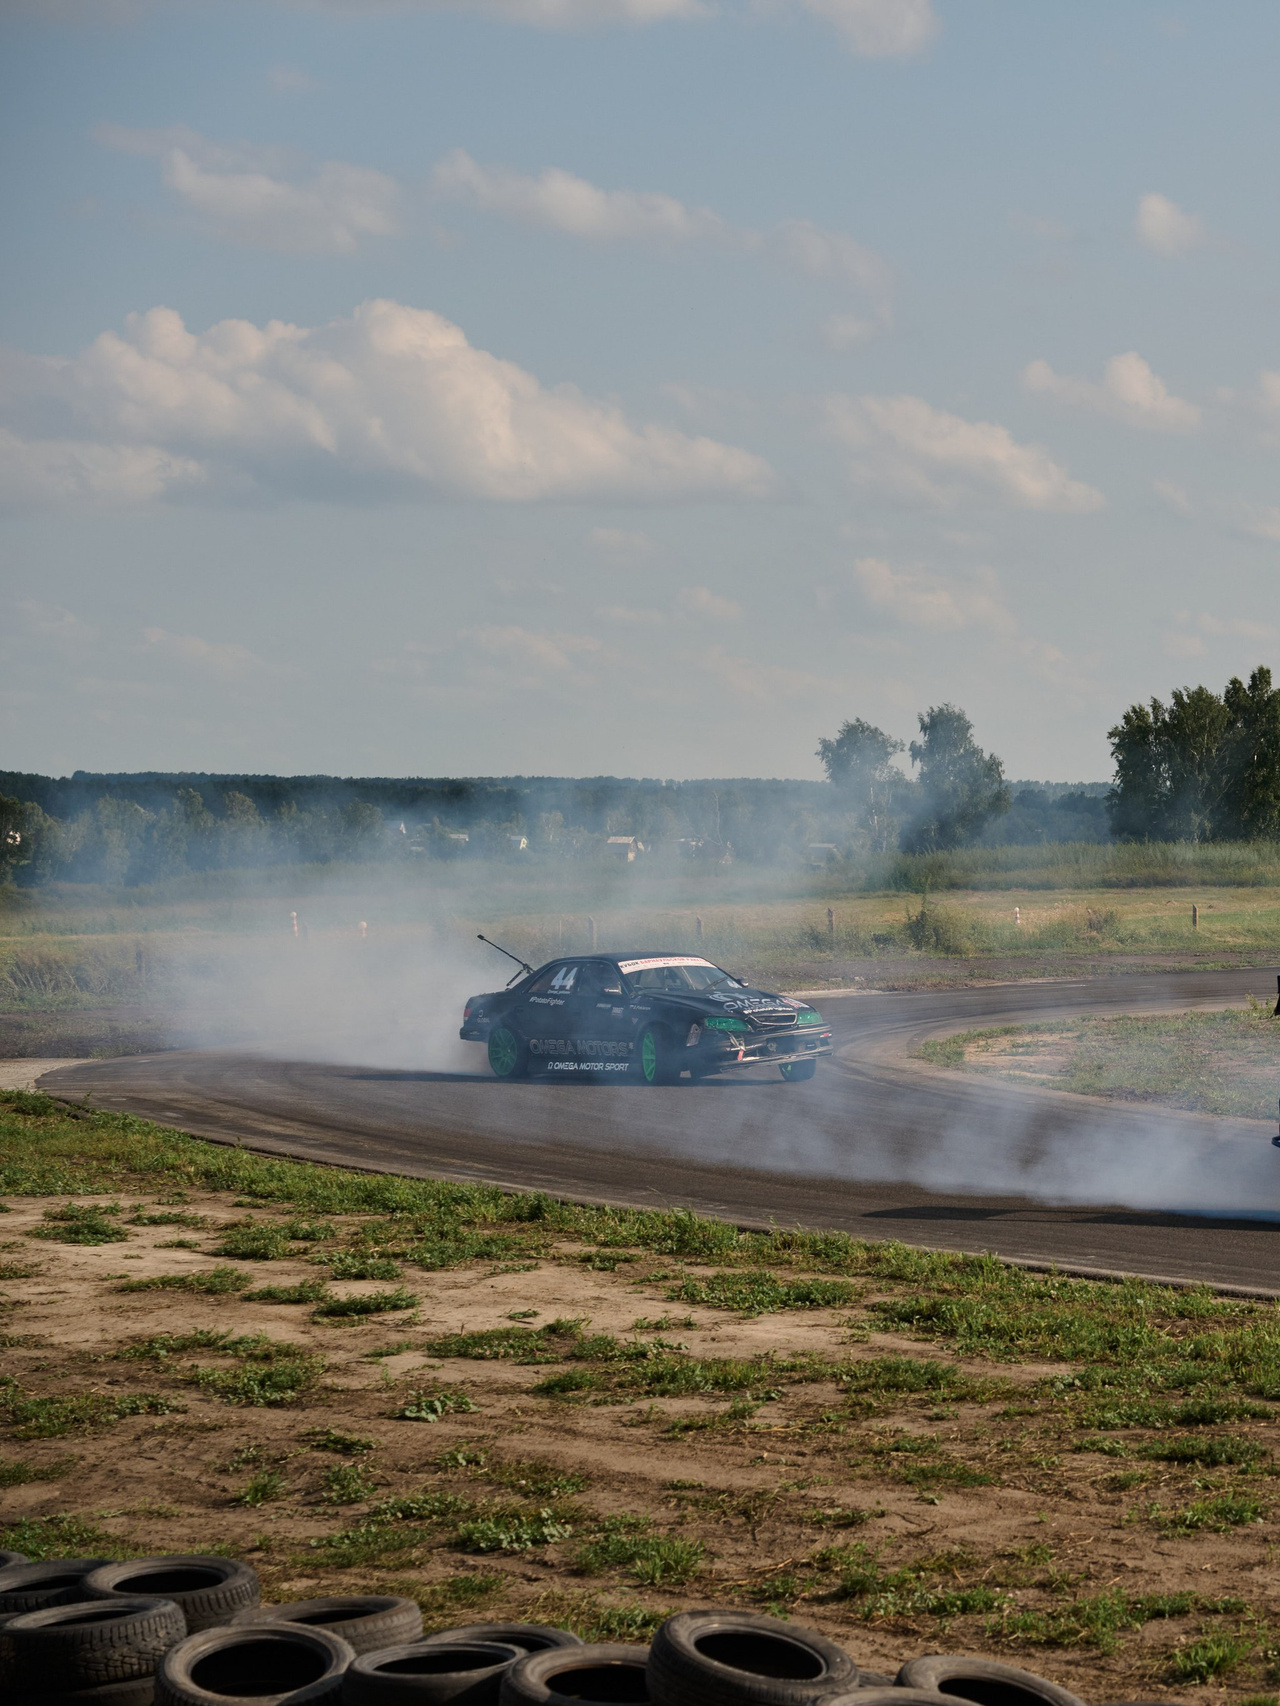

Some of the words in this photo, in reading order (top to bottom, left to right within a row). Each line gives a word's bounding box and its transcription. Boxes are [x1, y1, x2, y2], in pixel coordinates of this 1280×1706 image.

[620, 961, 639, 969] КУБОК
[550, 967, 578, 990] 44
[529, 996, 565, 1007] #PotatoFighter
[723, 998, 784, 1011] OMEGA
[529, 1039, 576, 1055] OMEGA
[576, 1039, 628, 1057] MOTORS
[554, 1062, 578, 1070] OMEGA
[579, 1062, 604, 1071] MOTOR
[605, 1062, 629, 1072] SPORT
